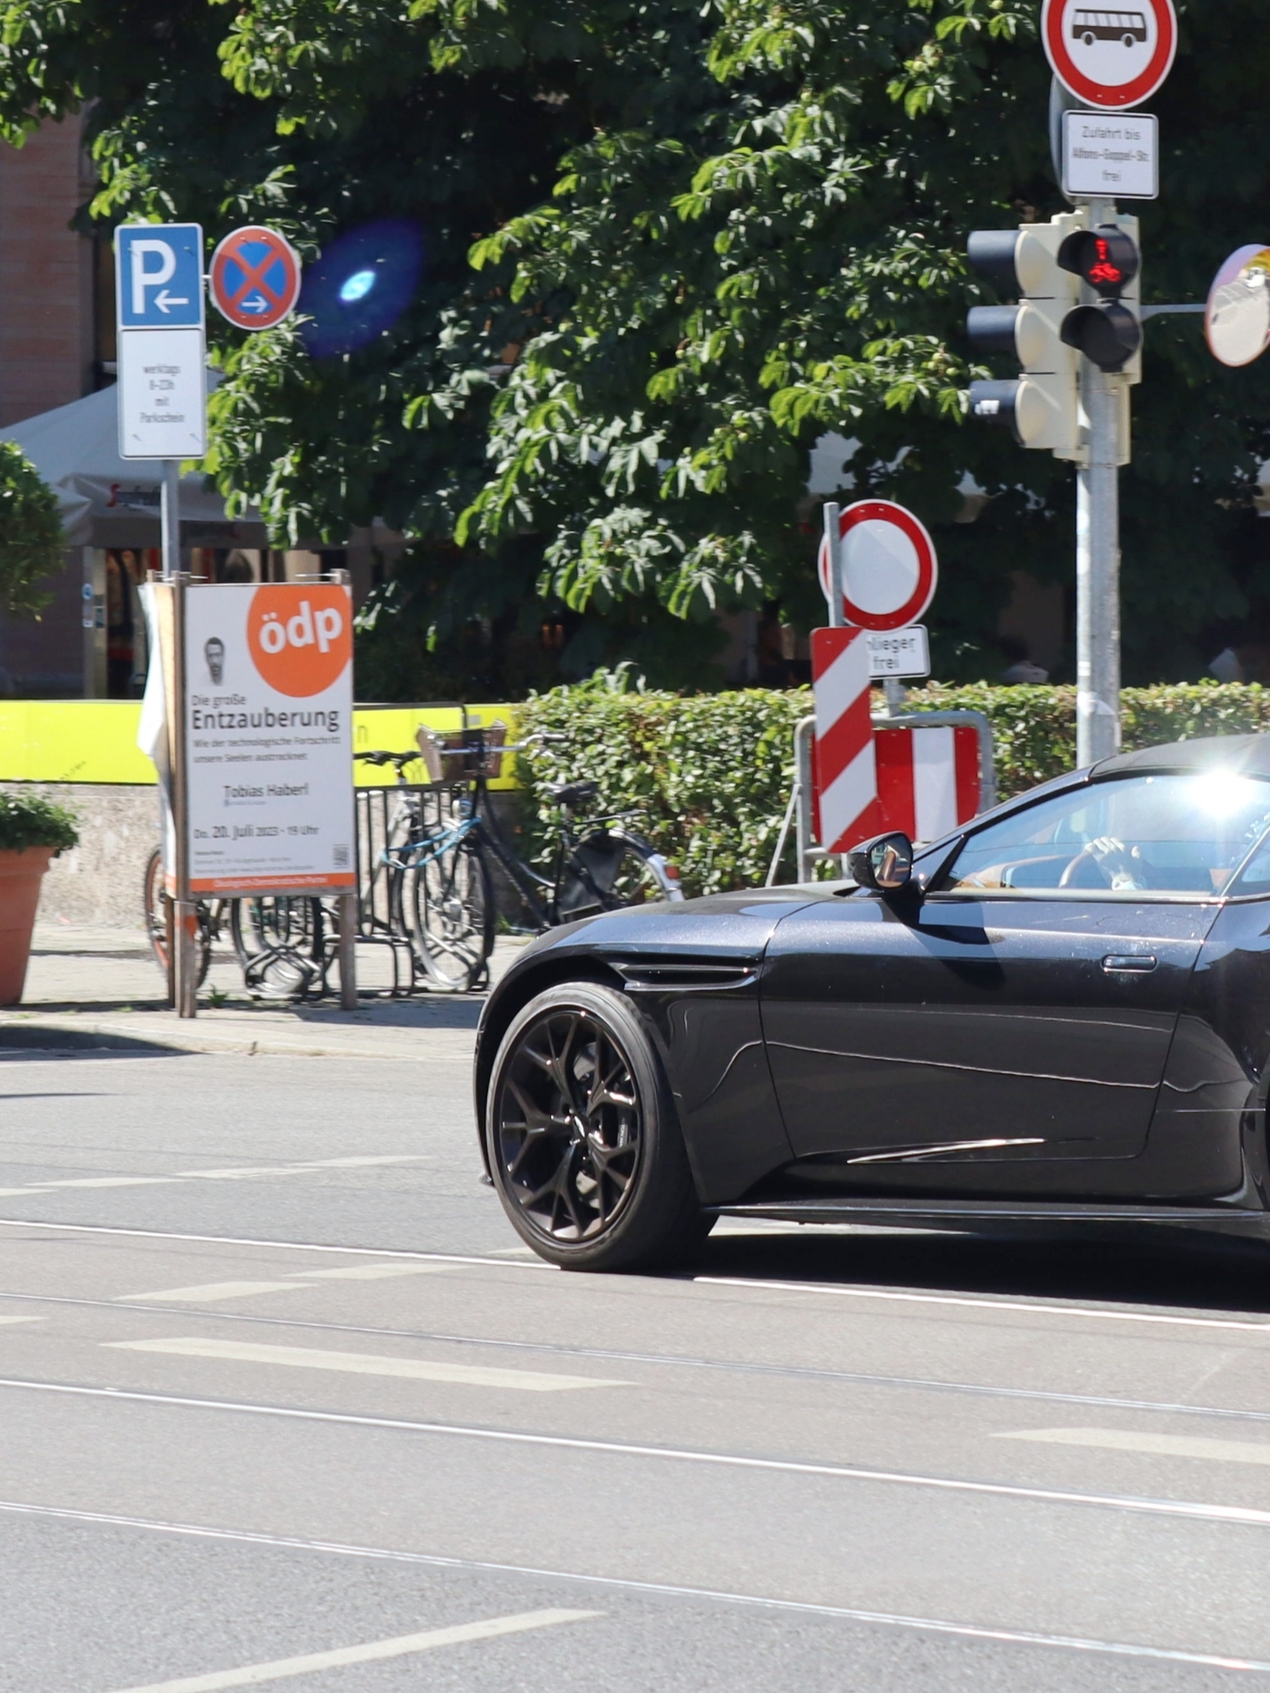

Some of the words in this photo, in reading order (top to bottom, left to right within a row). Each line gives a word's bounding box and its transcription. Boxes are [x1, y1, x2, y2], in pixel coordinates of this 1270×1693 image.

[1081, 126, 1121, 139] Zufahrt
[1124, 128, 1141, 140] bis
[1102, 170, 1121, 181] frei
[130, 239, 177, 314] P
[143, 364, 181, 376] werktags
[155, 396, 170, 407] mit
[140, 411, 185, 423] Parkschein
[259, 600, 343, 654] ödp
[873, 655, 899, 670] frei
[191, 694, 209, 706] Die
[212, 693, 247, 708] große
[191, 707, 340, 732] Entzauberung
[193, 739, 209, 748] Wie
[212, 738, 225, 747] der
[223, 784, 264, 798] Tobias
[266, 783, 309, 796] Haberl
[212, 826, 230, 838] 20.
[232, 824, 254, 840] Juli
[300, 825, 319, 835] Uhr
